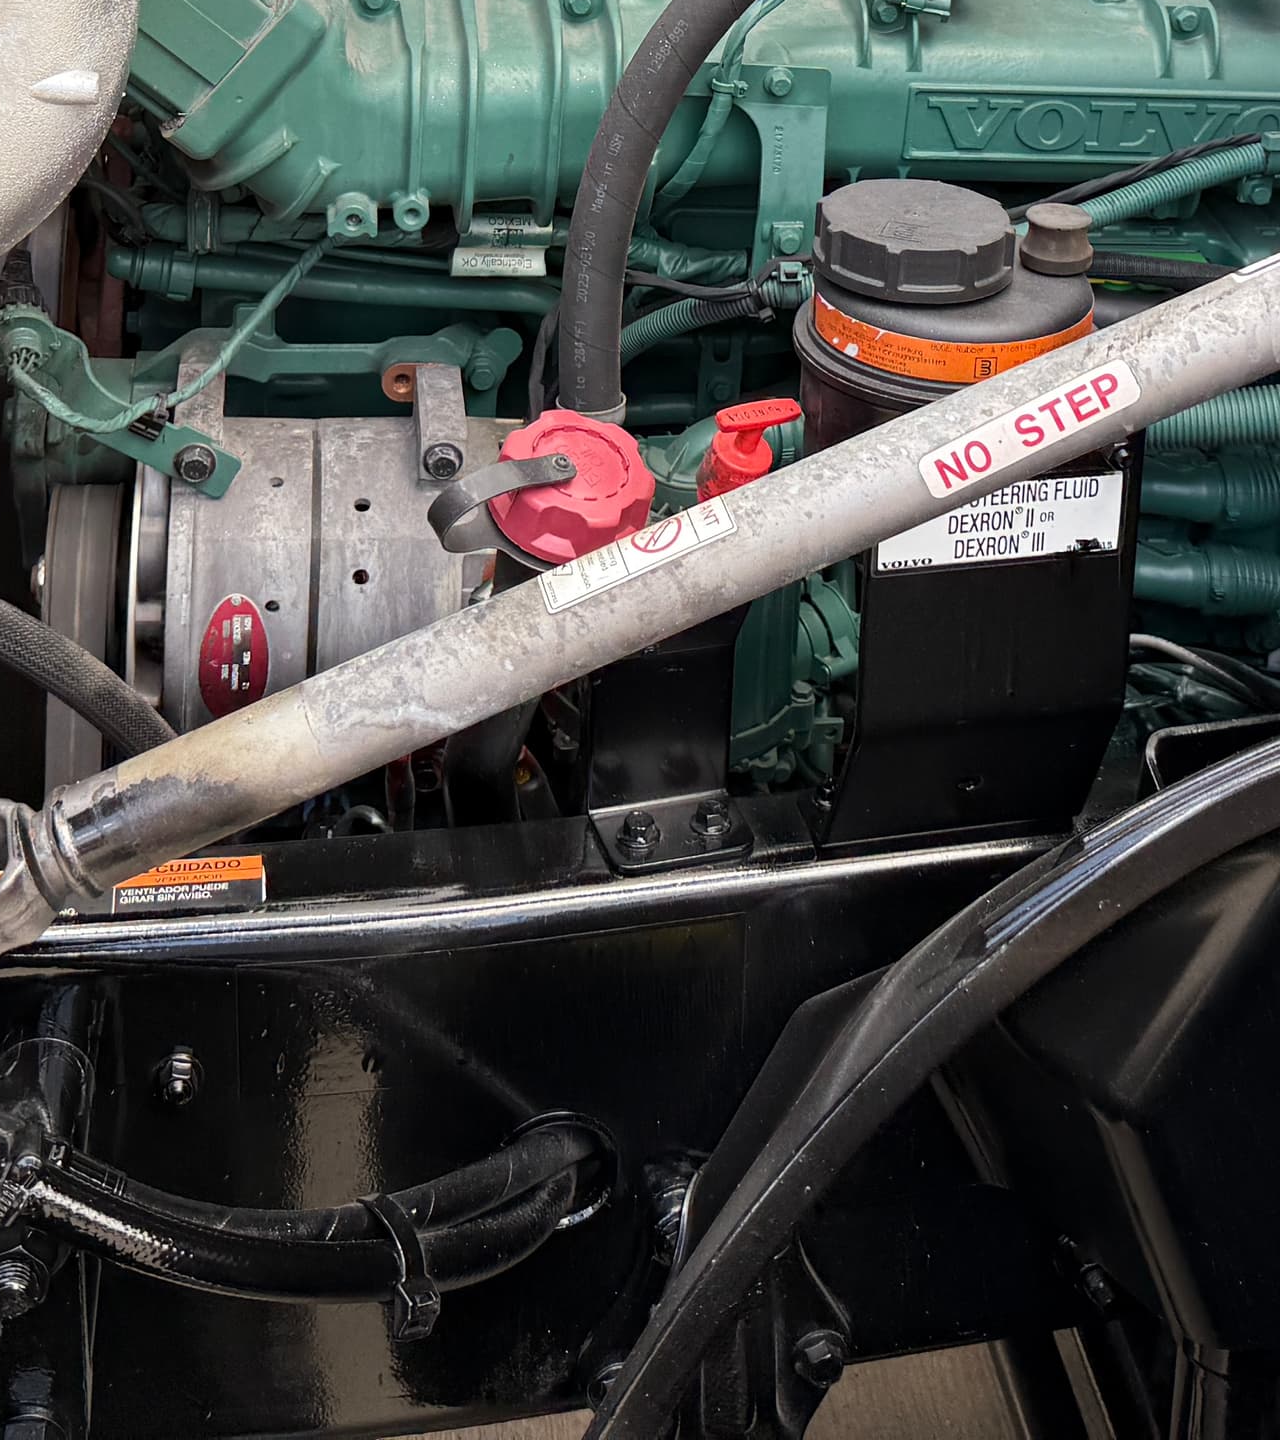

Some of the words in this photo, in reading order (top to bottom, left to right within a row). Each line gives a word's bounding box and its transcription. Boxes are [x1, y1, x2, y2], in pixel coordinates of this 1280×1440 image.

[589, 182, 609, 214] Made
[600, 161, 614, 178] in
[488, 216, 531, 226] MEXICO
[462, 258, 478, 267] OK
[481, 256, 532, 269] Electrically
[935, 441, 992, 490] NO
[1014, 372, 1119, 447] STEP
[1054, 478, 1100, 502] FLUID
[1026, 508, 1035, 527] II
[1040, 510, 1055, 523] OR
[1032, 532, 1045, 552] III
[881, 557, 934, 570] VOLVO
[154, 859, 242, 874] CUIDADO
[120, 884, 190, 897] VENTILADOR
[191, 881, 230, 893] PUEDE
[120, 895, 155, 905] GIRAR
[157, 892, 176, 902] SIN
[177, 890, 213, 901] AVISO.
